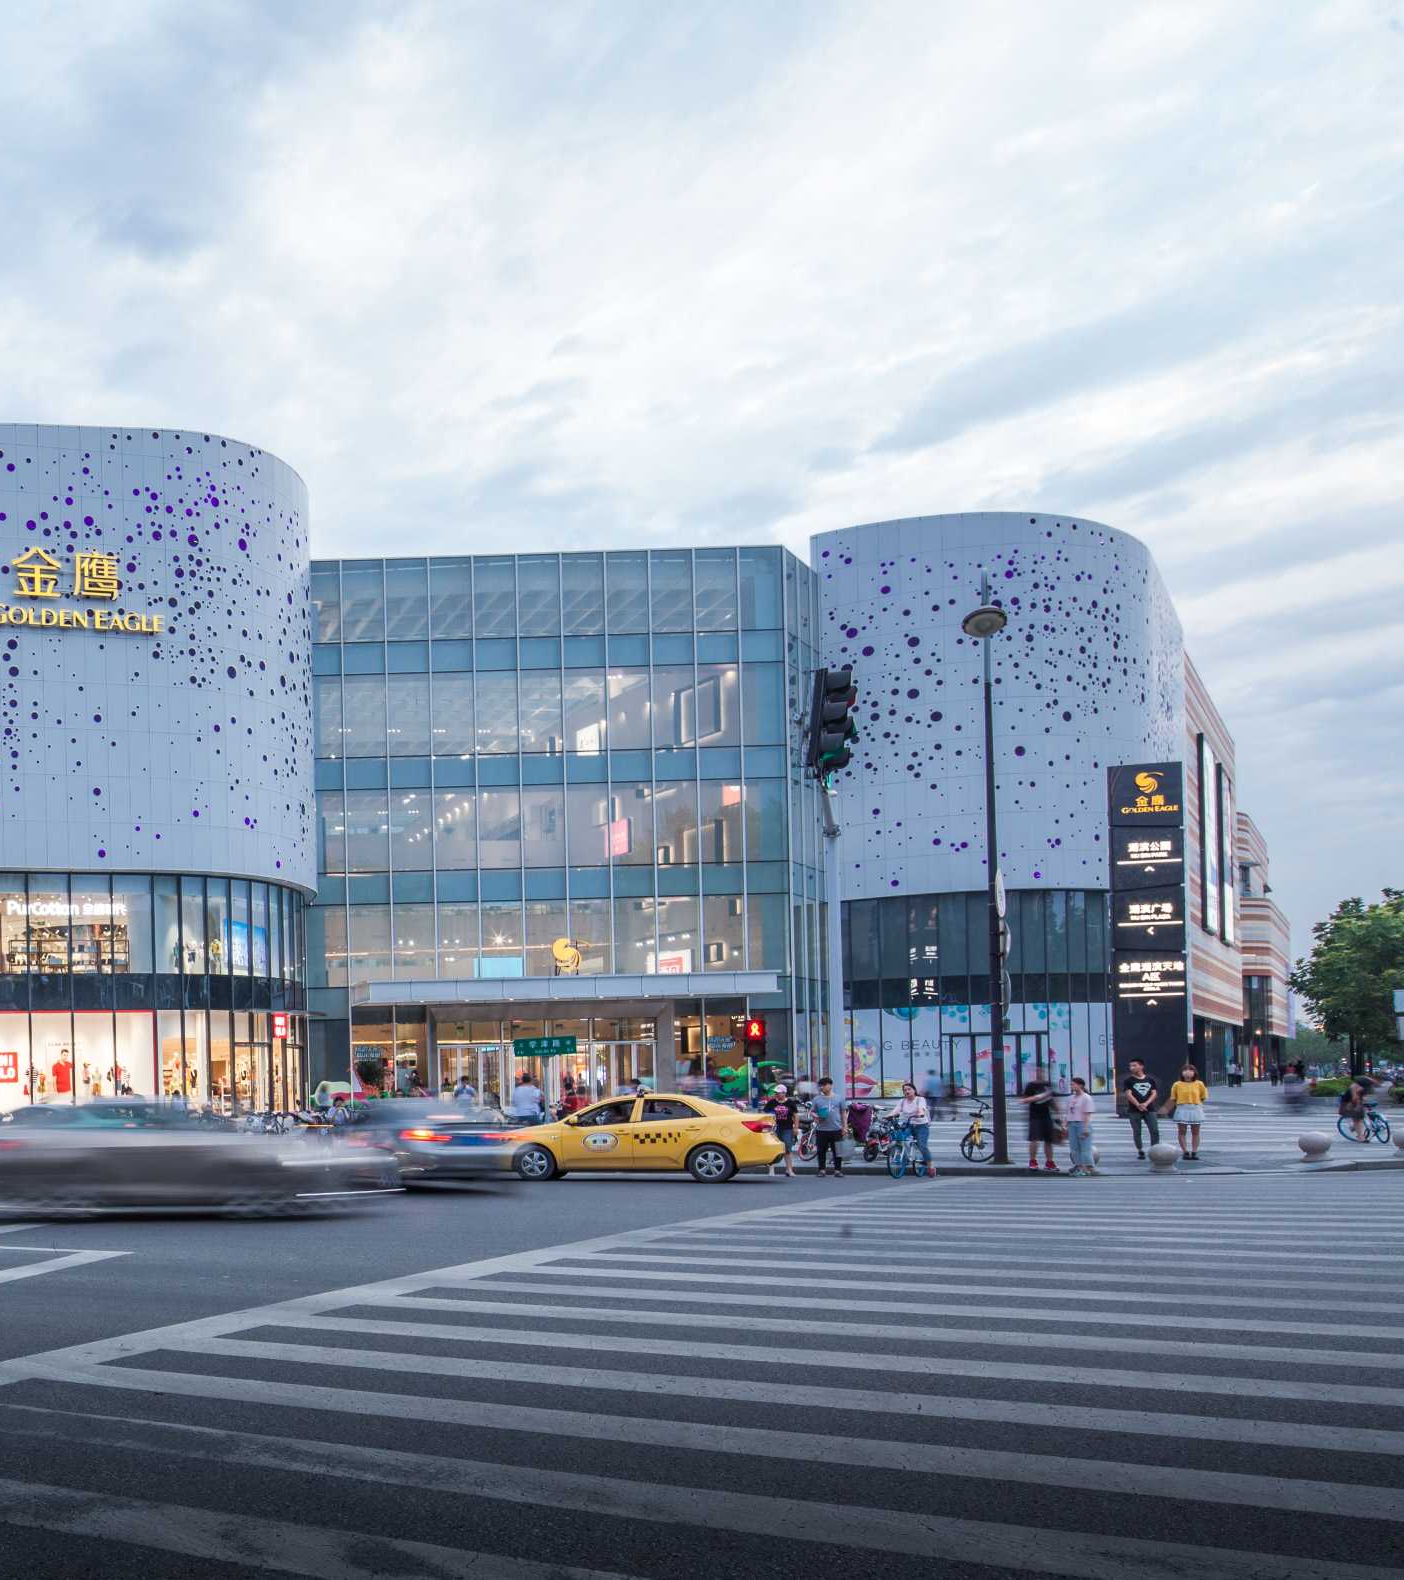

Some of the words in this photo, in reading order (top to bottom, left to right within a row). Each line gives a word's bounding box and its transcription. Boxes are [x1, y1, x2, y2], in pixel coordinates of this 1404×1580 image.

[11, 546, 117, 601] 金鹰
[94, 608, 164, 634] EAGLE
[1135, 795, 1164, 807] 金鹰
[1121, 806, 1154, 814] GOLDEN
[1155, 804, 1179, 812] EAGLE
[883, 1040, 893, 1051] G
[901, 1039, 962, 1051] BEAUTY
